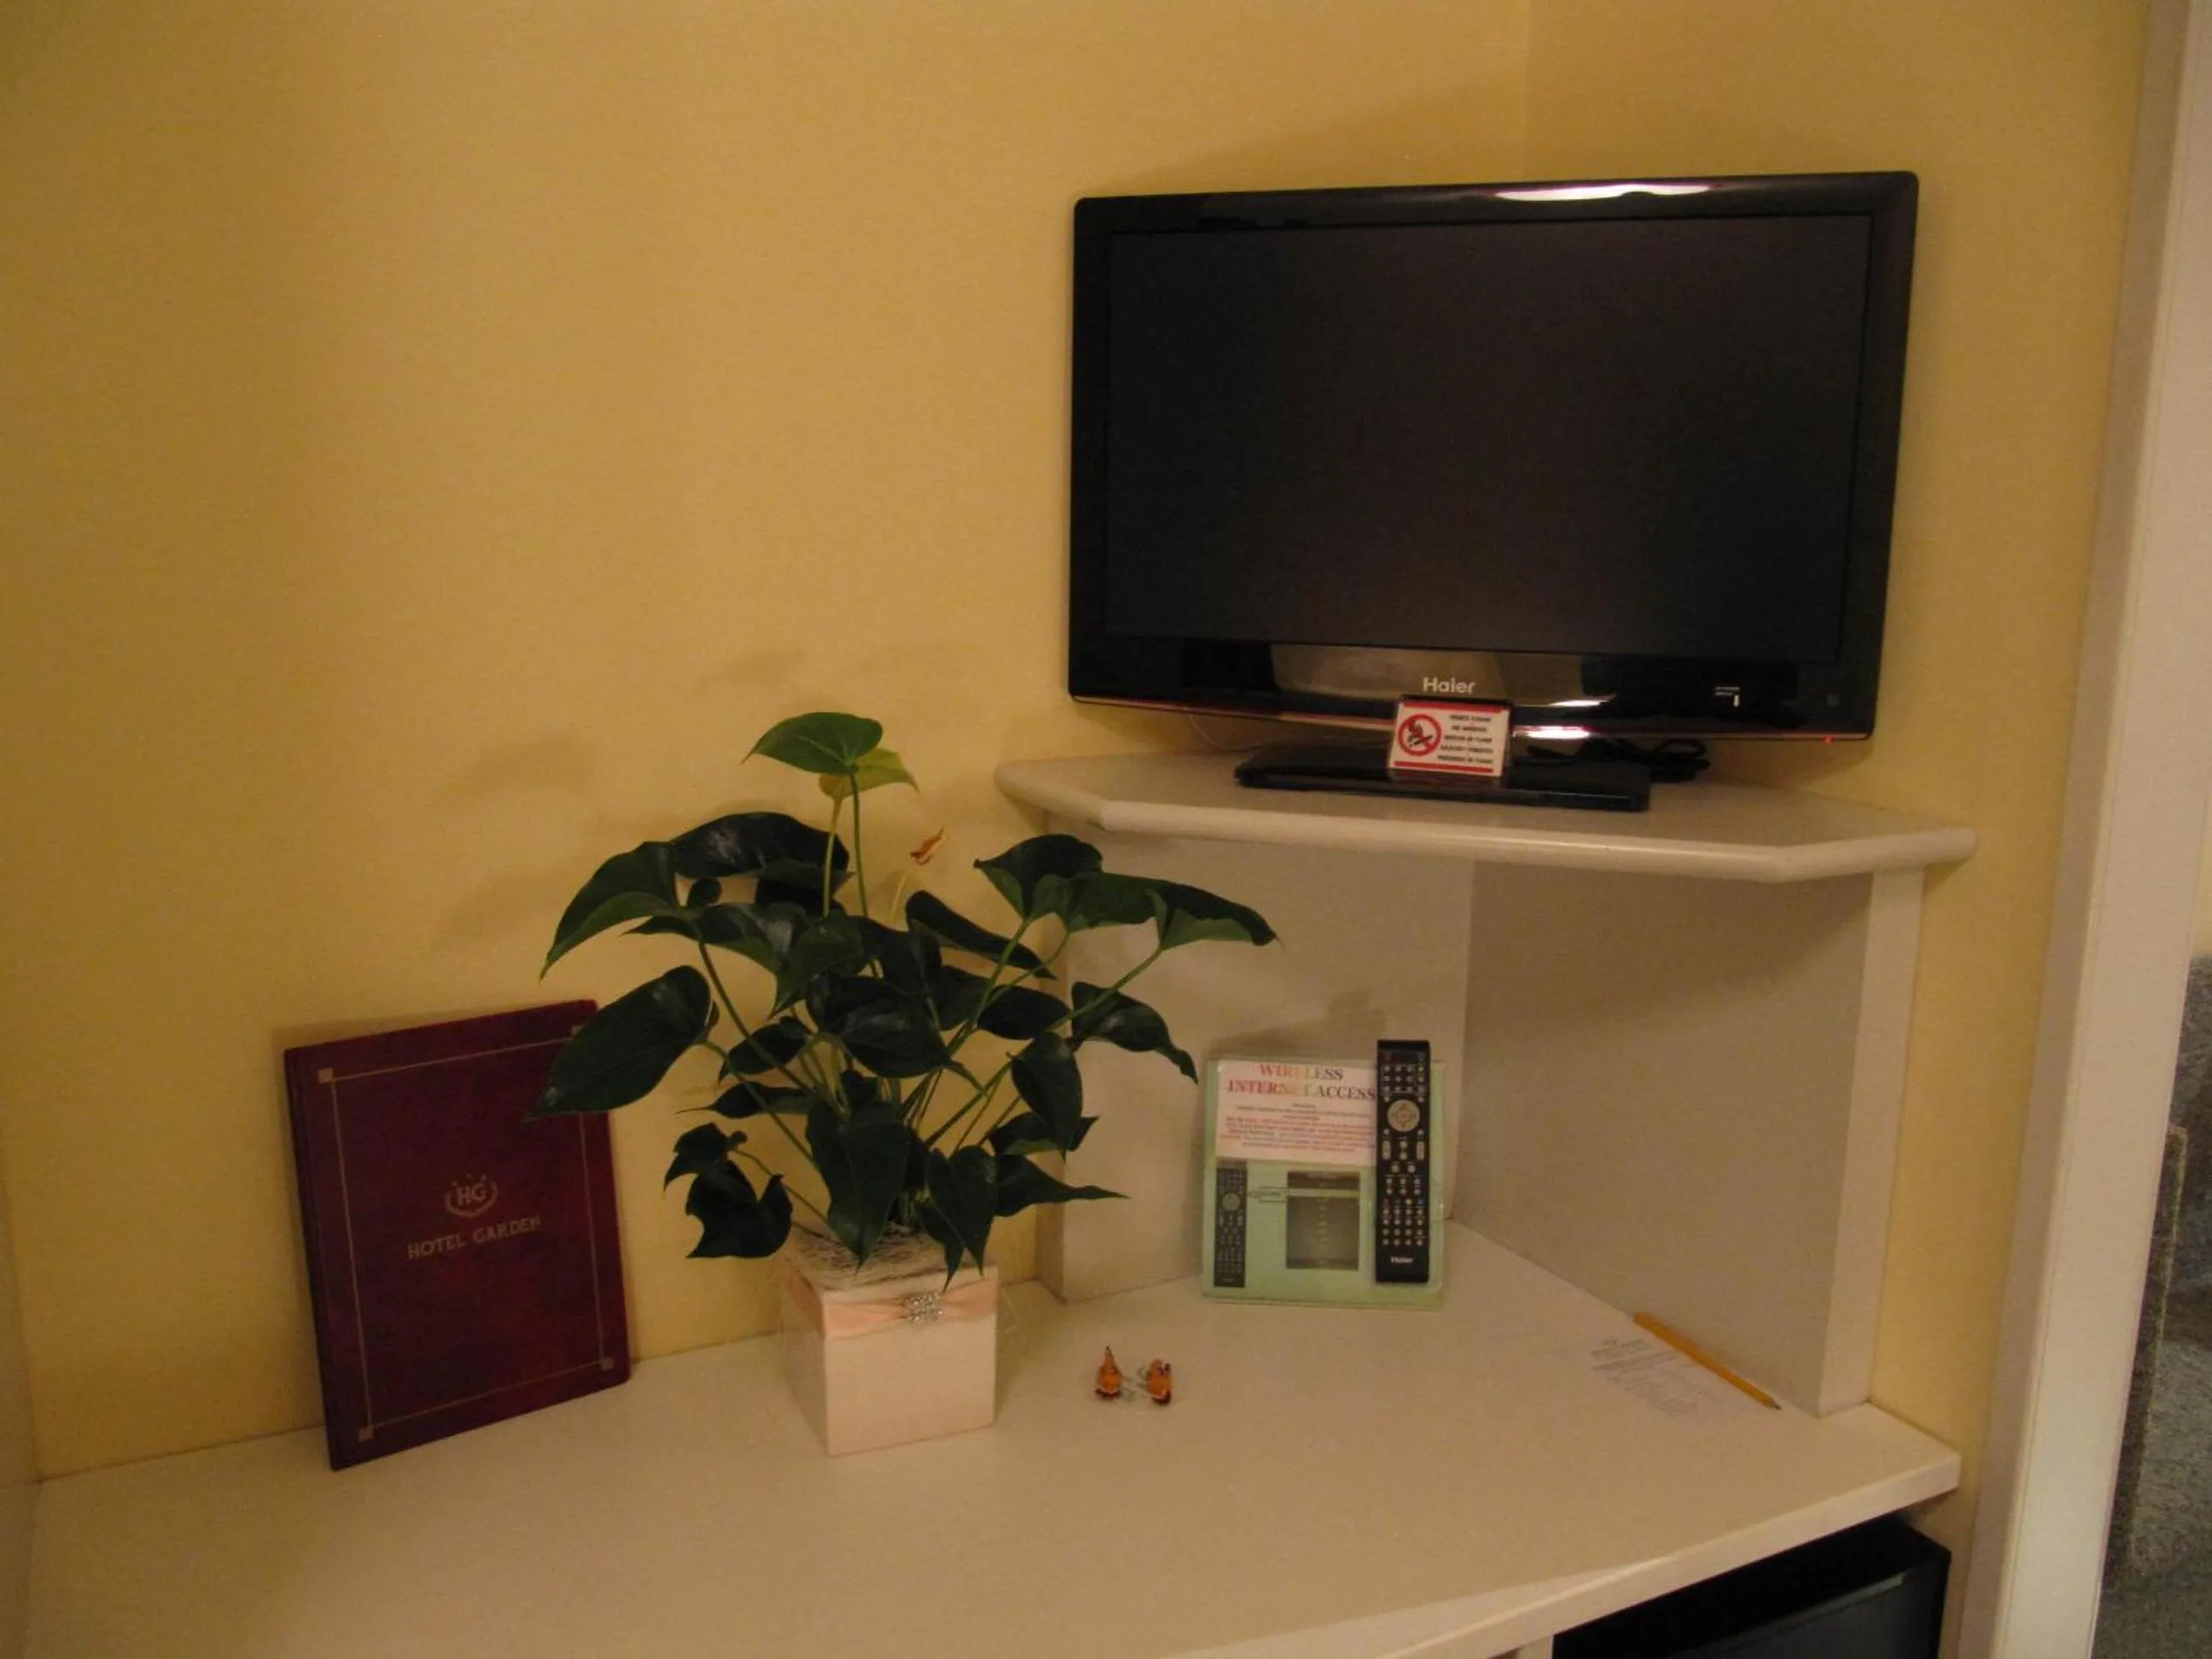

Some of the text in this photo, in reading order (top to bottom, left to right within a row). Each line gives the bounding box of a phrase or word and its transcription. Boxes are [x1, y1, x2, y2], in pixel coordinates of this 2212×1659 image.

[1423, 677, 1476, 694] Haier
[1227, 1079, 1377, 1101] INTERNT ACCESS
[408, 1215, 541, 1258] HOTEL GARDEN
